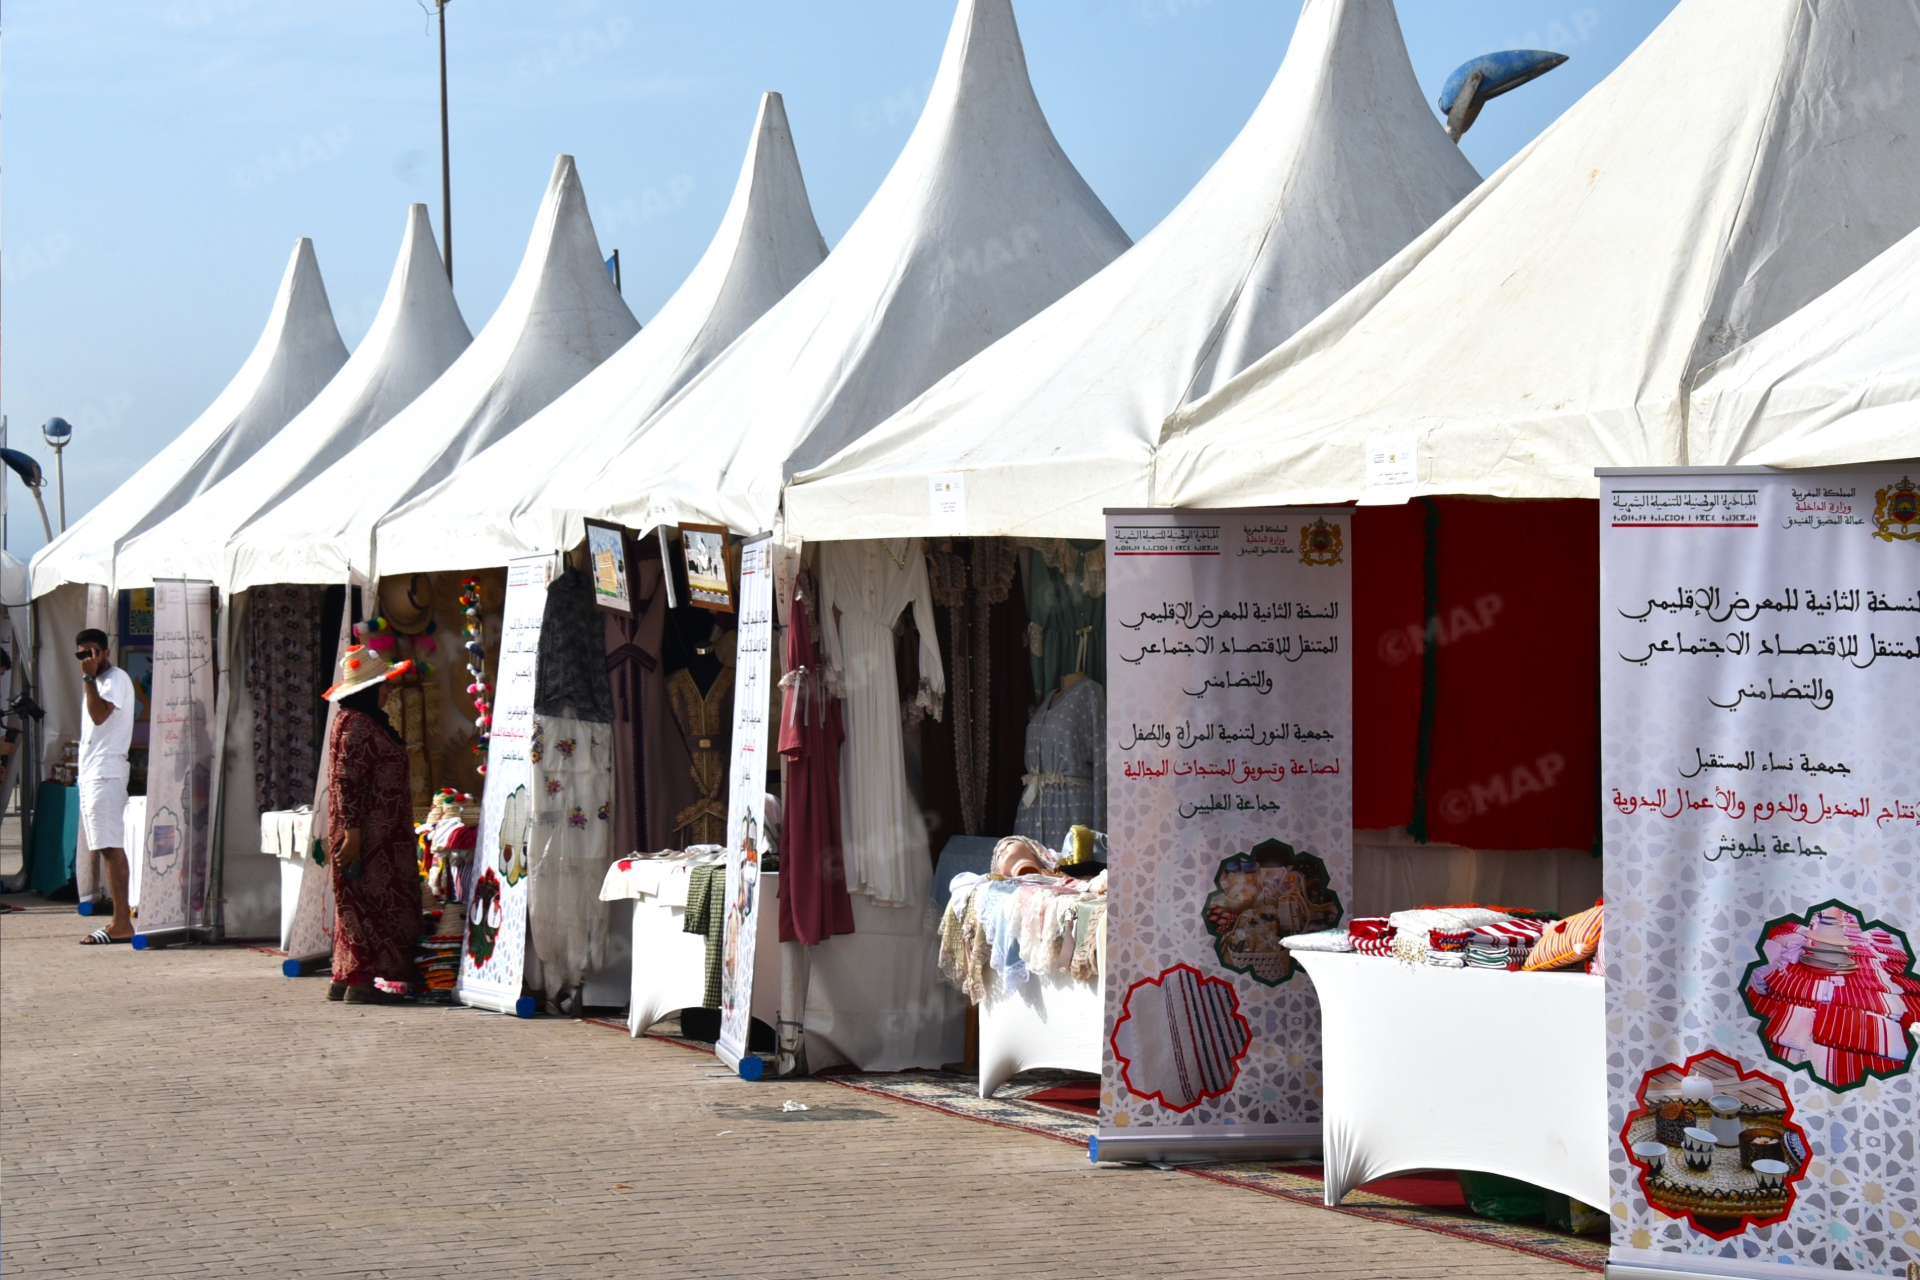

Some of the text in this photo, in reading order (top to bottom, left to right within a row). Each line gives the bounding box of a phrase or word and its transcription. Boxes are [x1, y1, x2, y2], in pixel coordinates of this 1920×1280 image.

[1792, 488, 1856, 501] المملكة المغربية
[1796, 501, 1852, 514] وزارة الداخلية
[1118, 601, 1339, 631] النسخة الثانية للمعرض الإقليمي
[1617, 586, 1920, 623] لنسخة الثانية للمعرض الإقليمي
[1119, 635, 1339, 666] المتنقل للاقتصاد الاجتماعي
[1617, 630, 1920, 668] لمتنقل للاقتصاد الاجتماعي
[1182, 670, 1273, 699] والتضامني
[1708, 678, 1835, 712] والتضامني
[1118, 719, 1335, 751] جمعية النور لتنمية المرأة والطفل
[1123, 758, 1340, 784] لصناعة وتسويق المنتجات المجالية
[1677, 747, 1852, 779] جمعية نساء المستقبل
[1178, 793, 1281, 819] جماعة العليين
[1611, 785, 1920, 829] نتاج المنديل والدوم والأعمال اليدوية
[1703, 832, 1828, 862] جماعة بليونش
